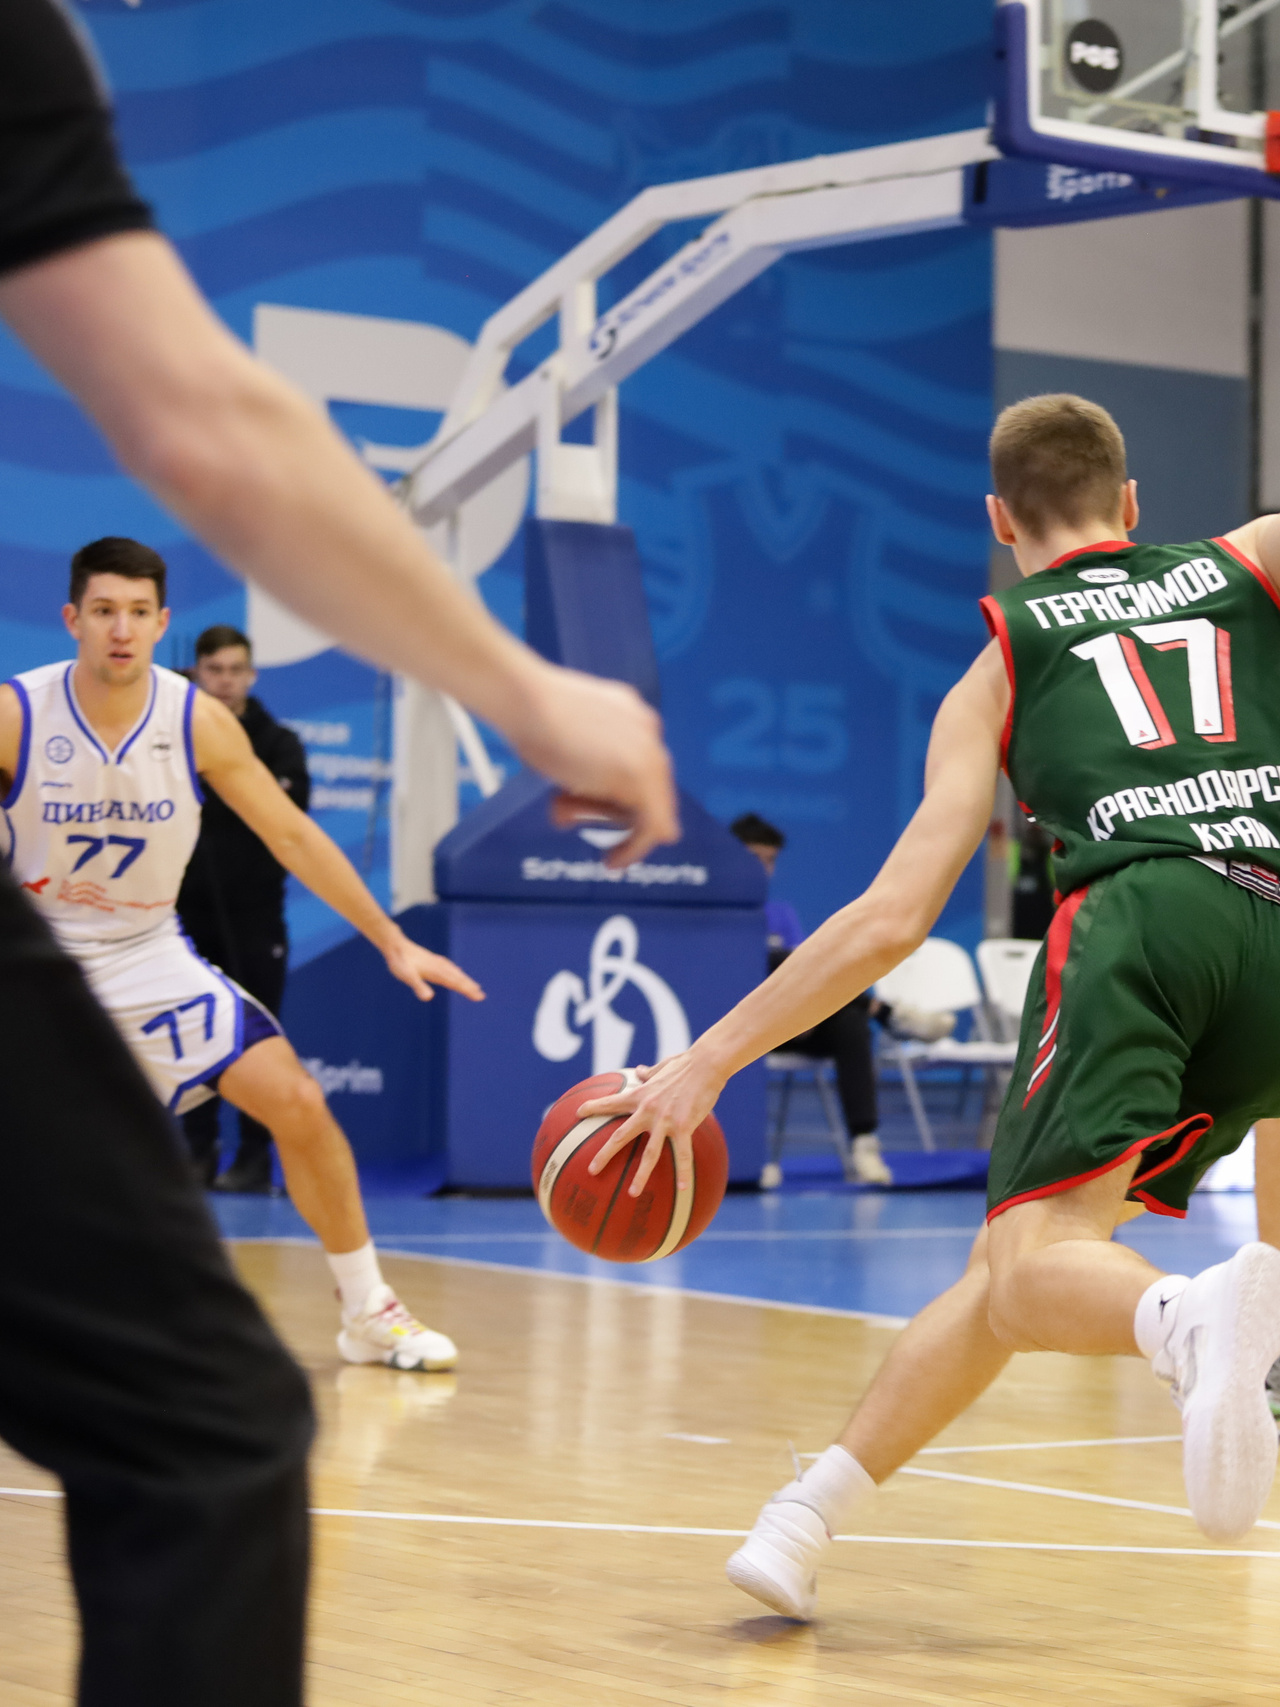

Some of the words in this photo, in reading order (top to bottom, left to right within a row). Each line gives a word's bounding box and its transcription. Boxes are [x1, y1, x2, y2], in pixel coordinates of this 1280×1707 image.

[1024, 557, 1228, 629] ГЕРАСИМОВ
[1069, 618, 1237, 750] 17
[66, 834, 147, 879] 77
[140, 993, 215, 1061] 77
